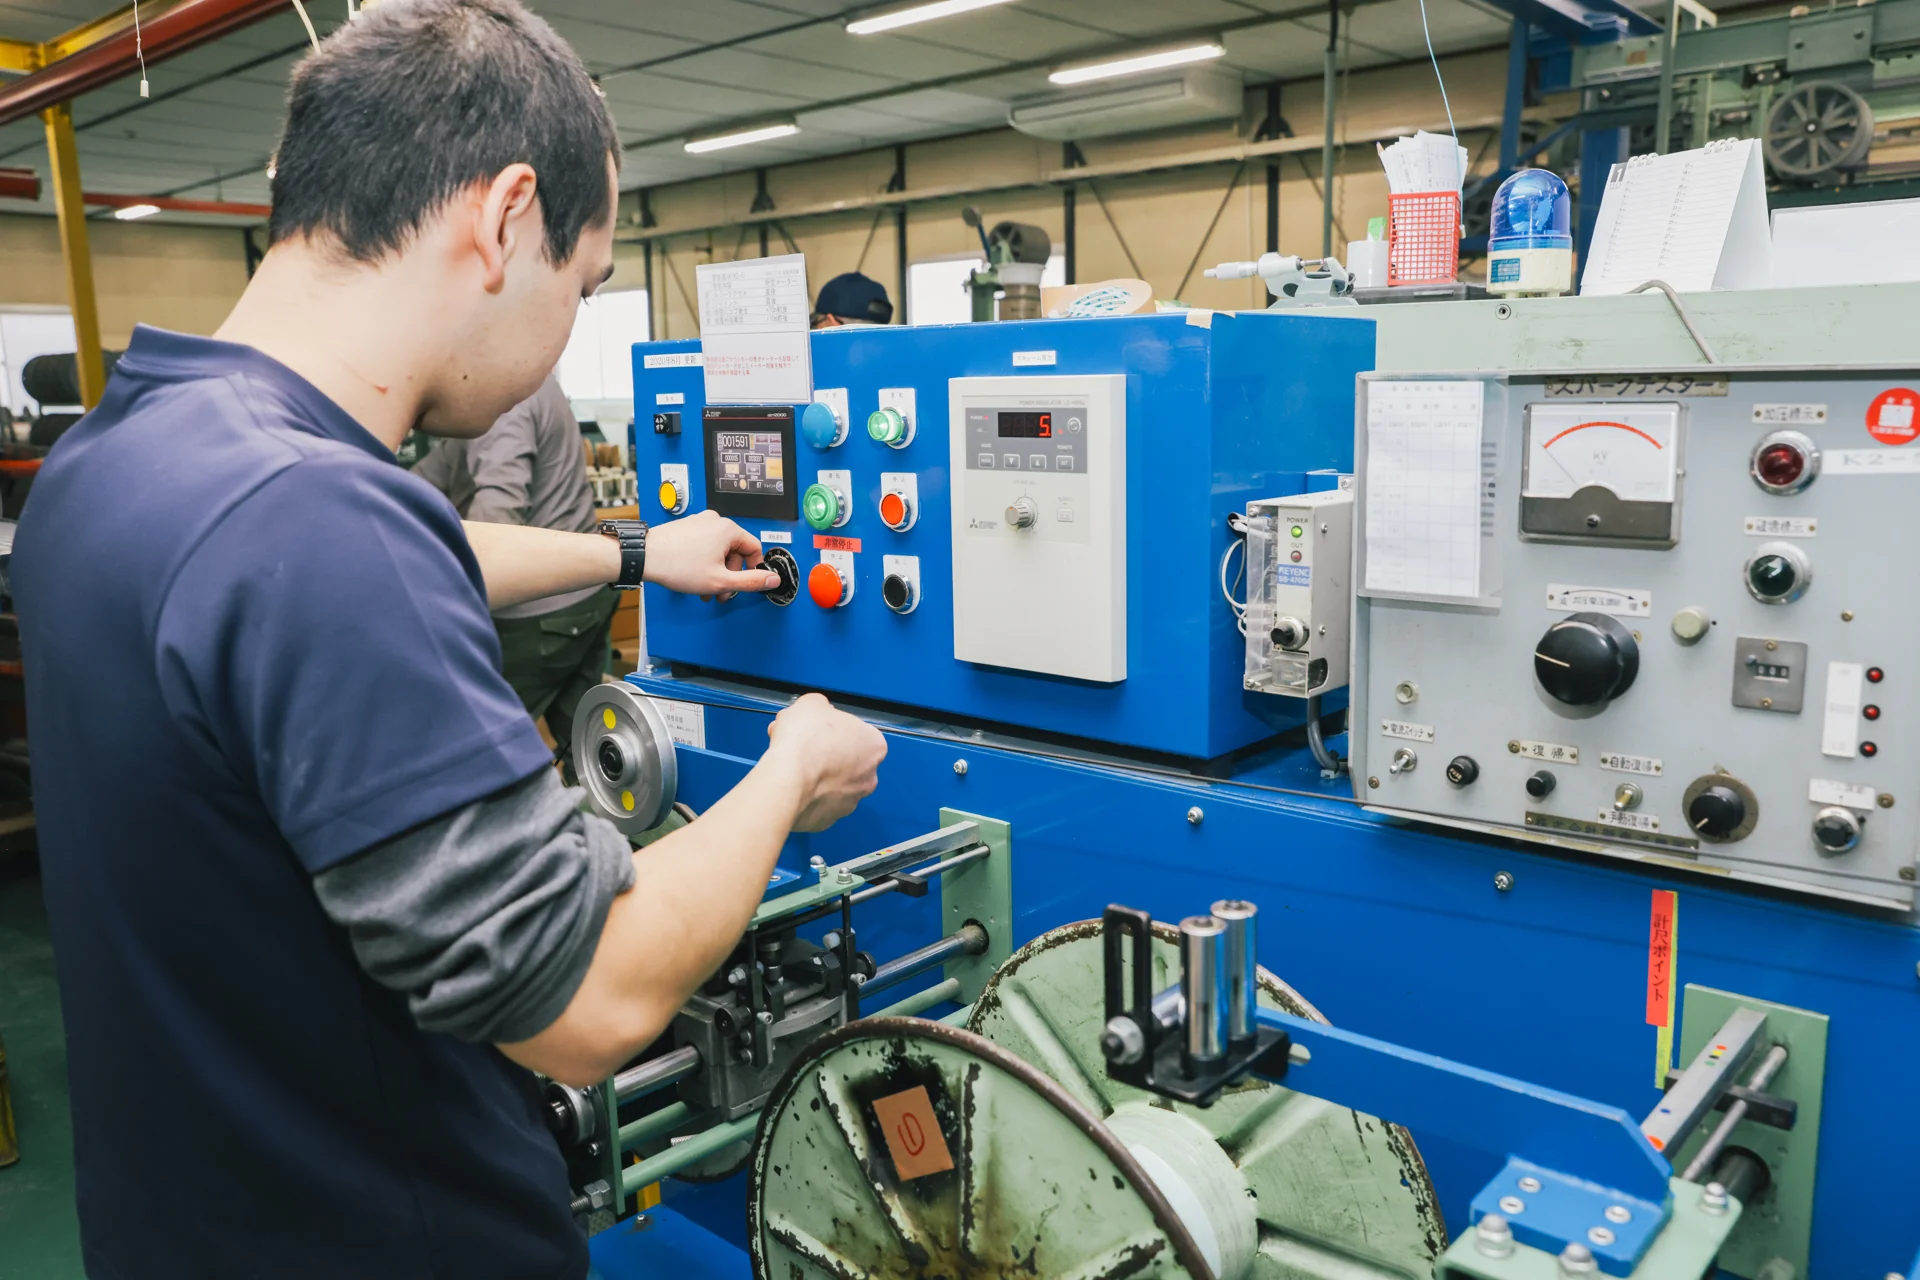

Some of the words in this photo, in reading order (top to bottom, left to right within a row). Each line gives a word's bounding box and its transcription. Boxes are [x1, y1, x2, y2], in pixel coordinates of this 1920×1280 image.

[723, 435, 748, 448] 001591
[1843, 453, 1920, 466] K2-
[824, 538, 854, 551] 非常停止
[1652, 913, 1670, 1002] 計尺ポイント
